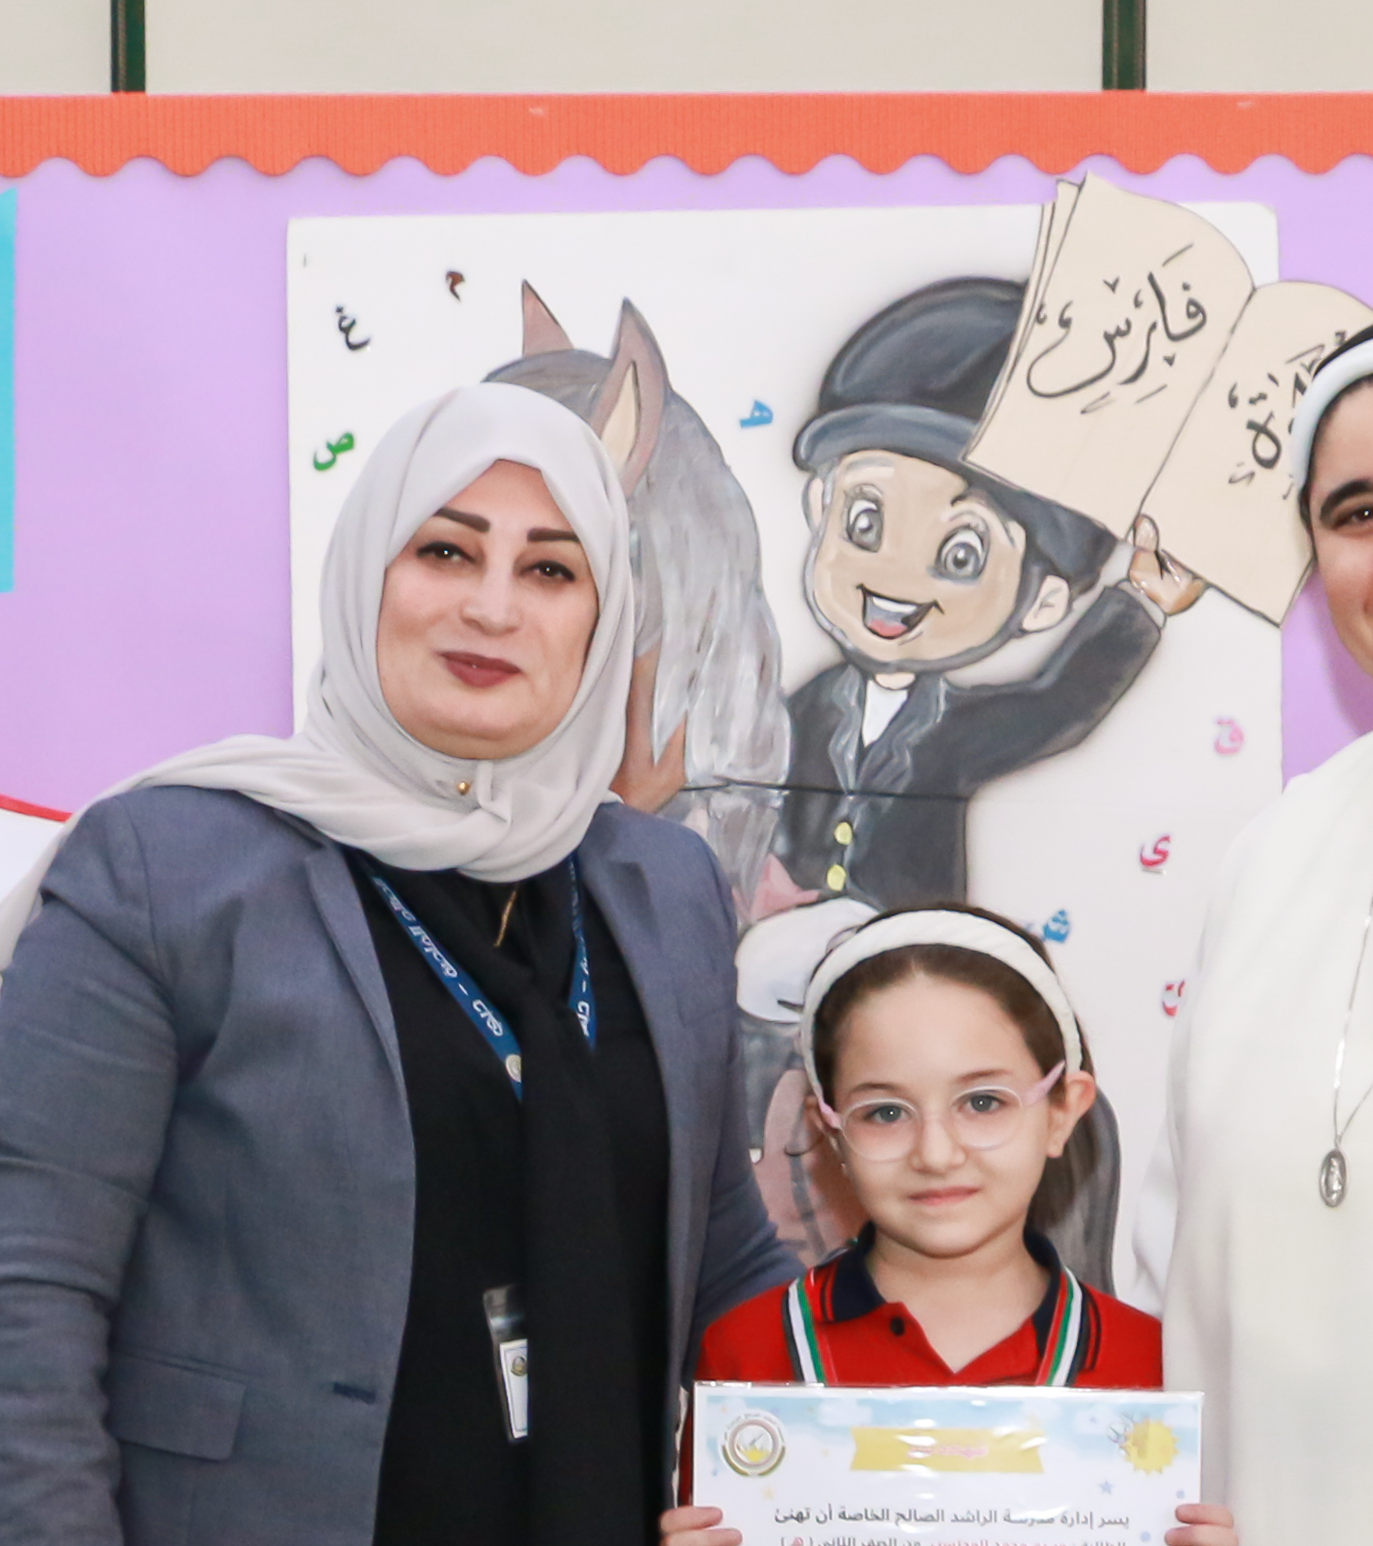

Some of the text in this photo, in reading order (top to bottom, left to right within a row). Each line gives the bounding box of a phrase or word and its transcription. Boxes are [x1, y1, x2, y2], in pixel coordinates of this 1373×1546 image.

[335, 305, 371, 351] غ
[313, 432, 355, 472] ص
[774, 1507, 811, 1524] تهنئ
[815, 1502, 833, 1525] أن
[837, 1506, 890, 1523] الخاصة
[894, 1508, 946, 1527] الصالح
[950, 1509, 998, 1527] الراشد
[1097, 1516, 1130, 1530] يسر
